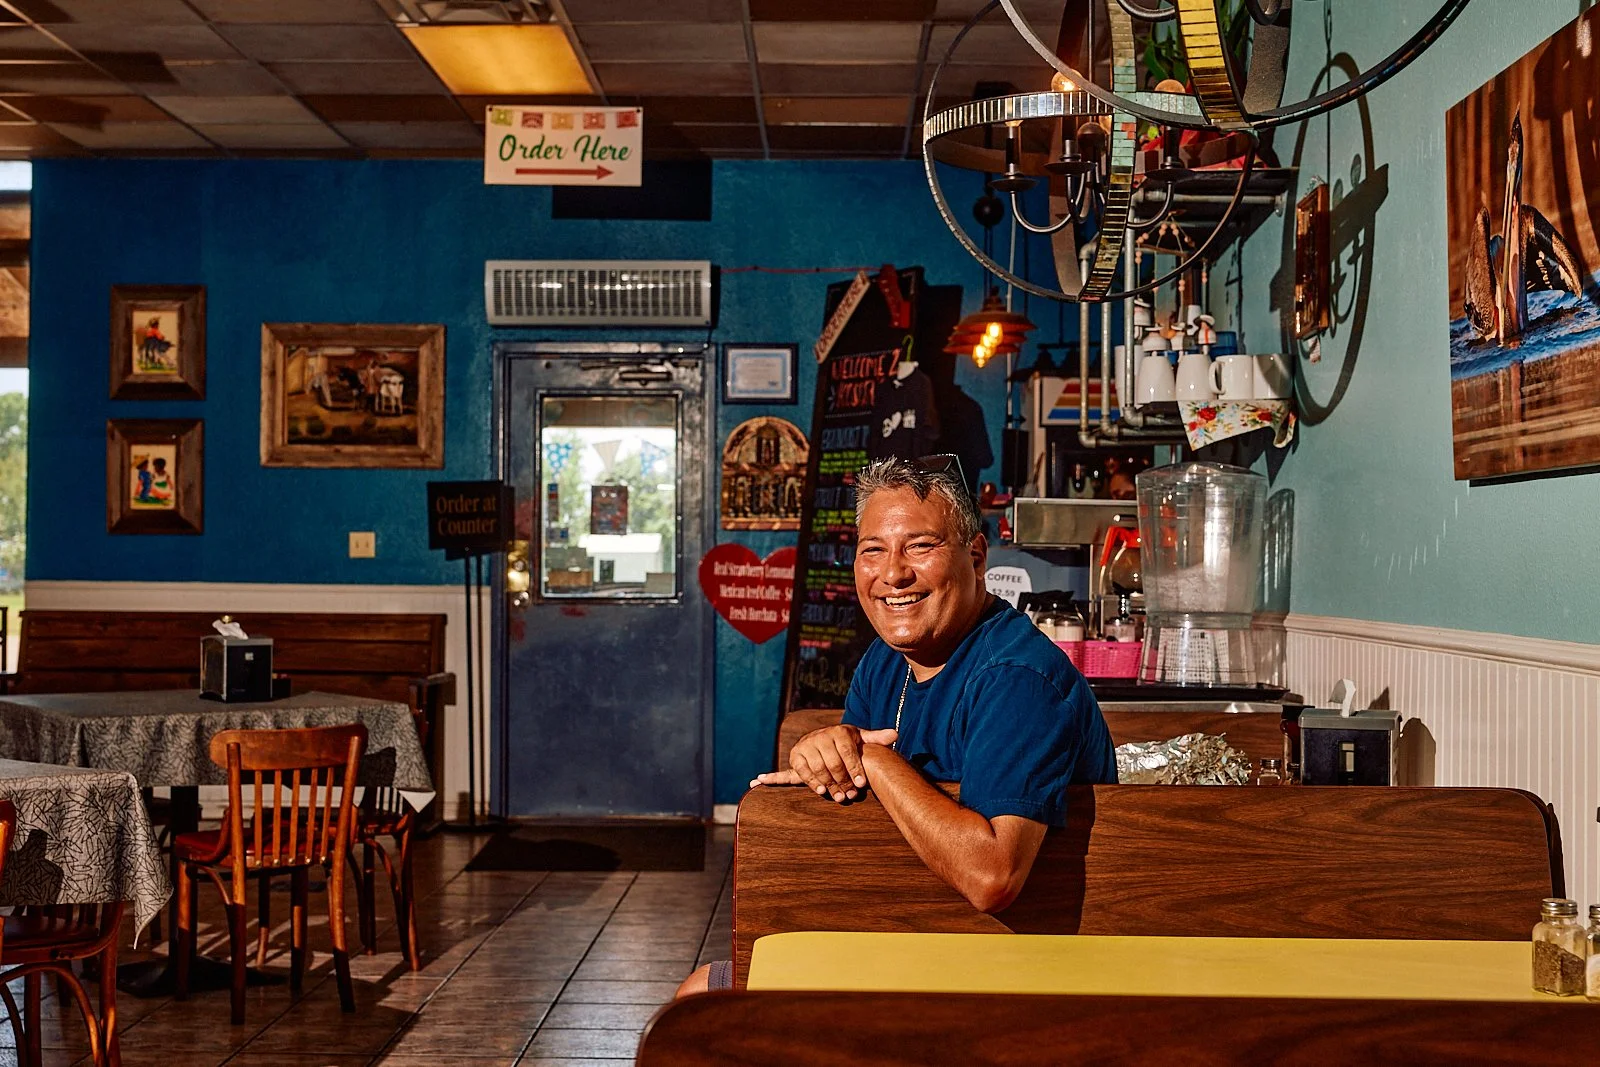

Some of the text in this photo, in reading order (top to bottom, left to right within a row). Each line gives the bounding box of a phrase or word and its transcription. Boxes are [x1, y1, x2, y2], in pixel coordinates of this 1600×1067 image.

[499, 134, 632, 162] Order Here
[831, 353, 887, 380] WELCOME
[436, 493, 497, 514] Order at
[438, 517, 497, 536] Counter
[713, 561, 728, 576] Real
[728, 561, 764, 580] Strawberry
[987, 572, 1023, 584] COFFEE
[719, 583, 746, 599] Mexican
[746, 585, 760, 600] Iced
[760, 585, 782, 601] Coffee
[992, 588, 1016, 597] $2.59
[729, 605, 748, 621] Fresh
[748, 606, 778, 622] Horchata
